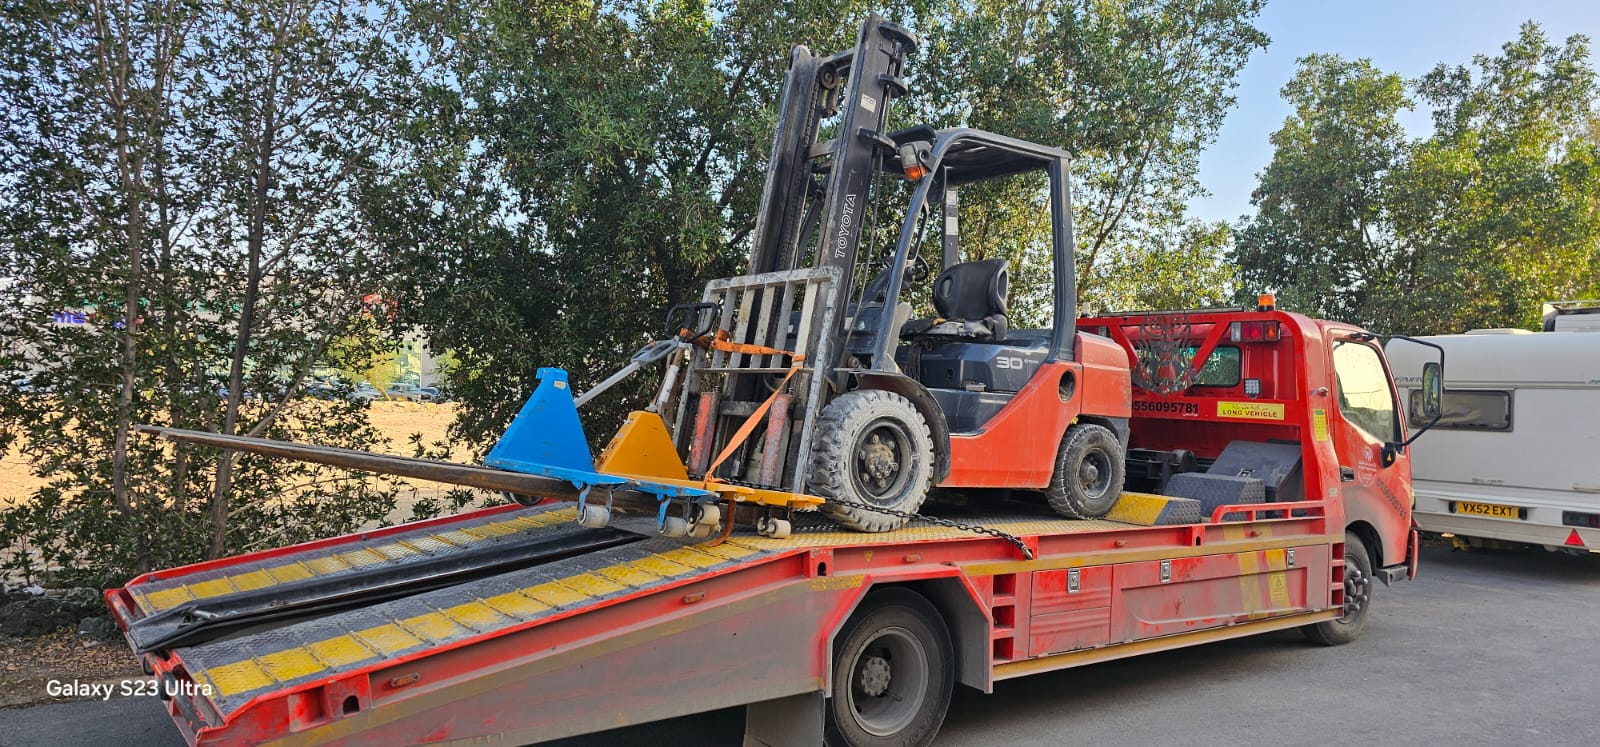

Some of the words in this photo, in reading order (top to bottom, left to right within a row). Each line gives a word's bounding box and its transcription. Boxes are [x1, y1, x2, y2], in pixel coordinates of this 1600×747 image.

[834, 193, 857, 258] TOYOTA
[996, 356, 1023, 370] 30
[1132, 401, 1199, 414] 556095781
[1245, 410, 1278, 418] VEHICLE
[1463, 503, 1490, 514] VX52
[1492, 505, 1513, 516] EXT
